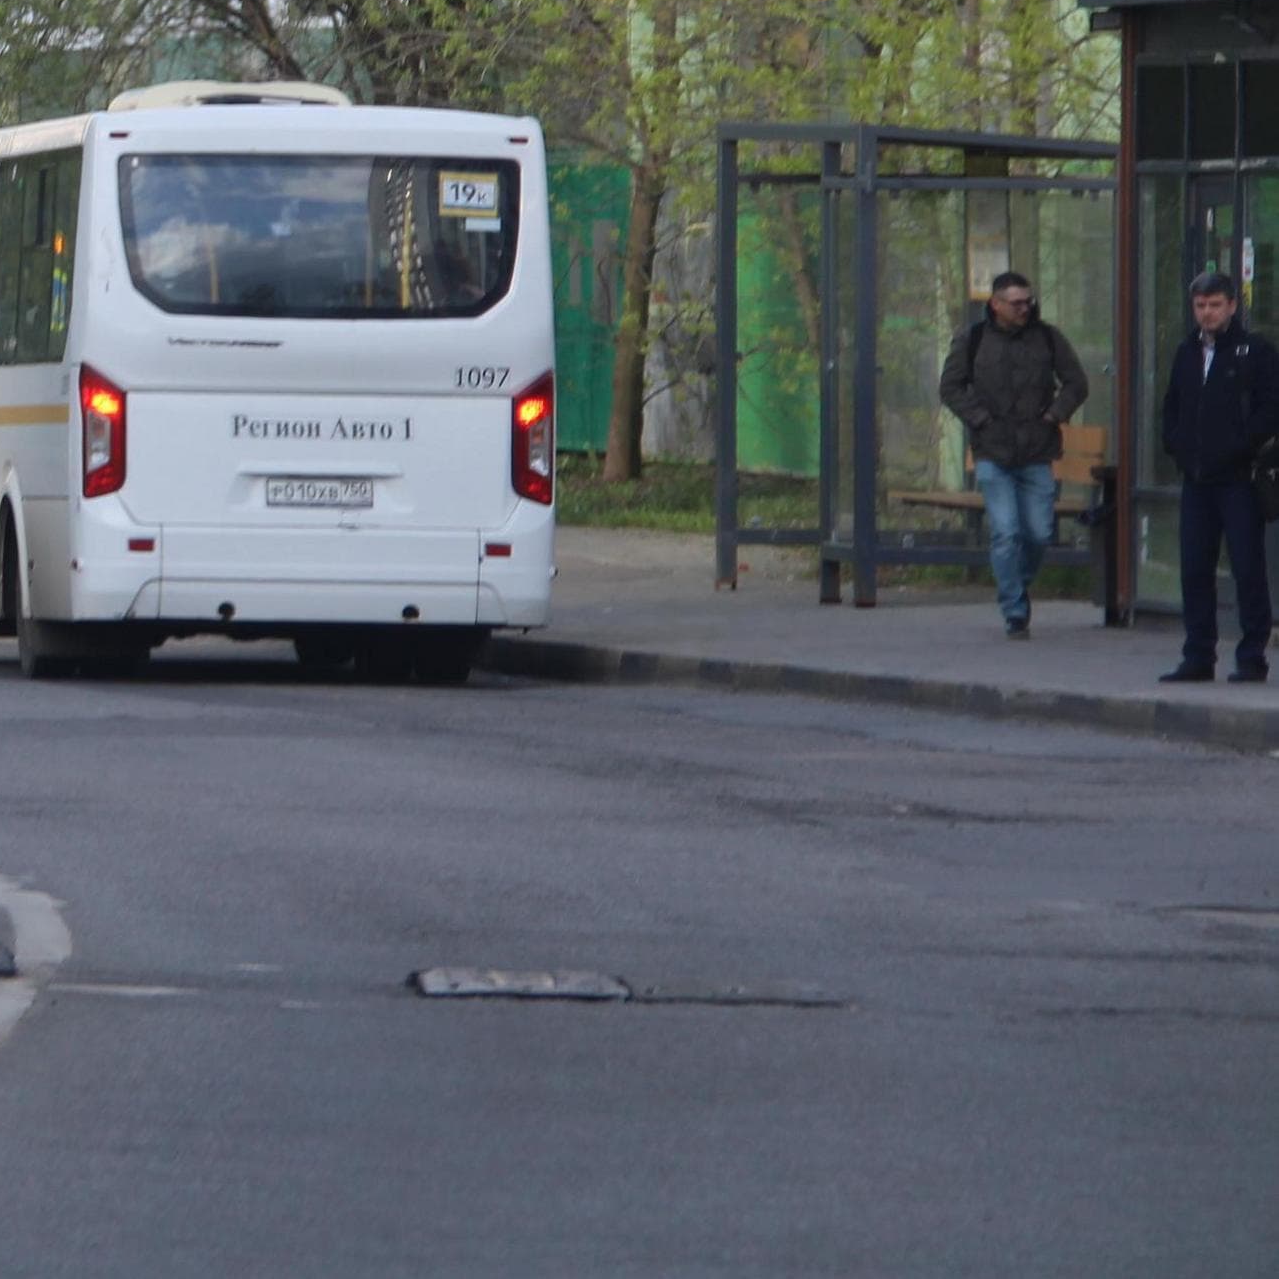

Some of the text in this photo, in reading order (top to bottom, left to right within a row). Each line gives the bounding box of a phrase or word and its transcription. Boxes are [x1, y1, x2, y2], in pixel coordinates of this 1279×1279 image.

[455, 367, 511, 389] 1097
[232, 414, 321, 439] Регион
[330, 417, 393, 441] Авто
